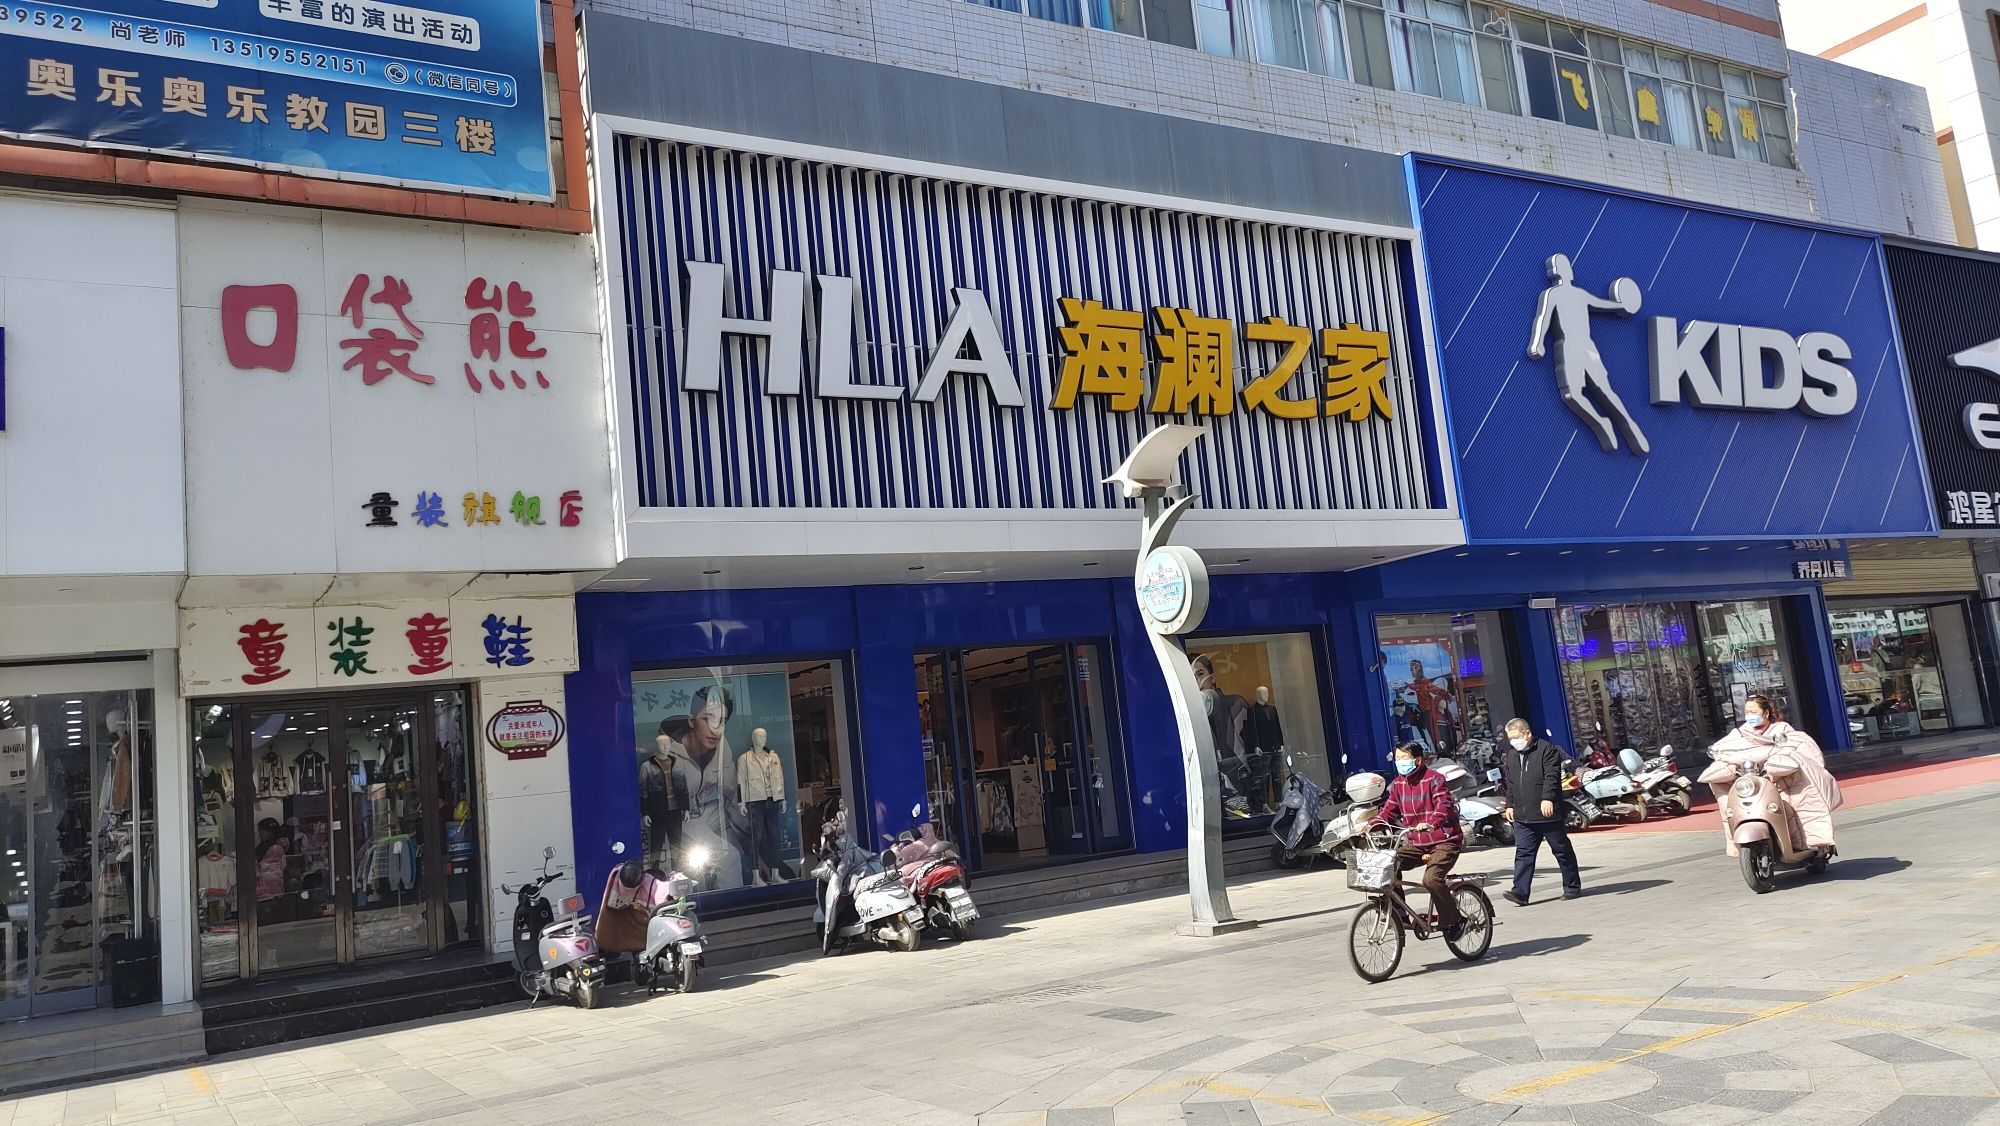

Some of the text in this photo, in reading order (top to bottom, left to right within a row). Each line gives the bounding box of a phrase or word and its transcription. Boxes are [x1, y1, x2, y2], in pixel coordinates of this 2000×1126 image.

[110, 21, 187, 48] 尚老师
[210, 37, 368, 75] 13519552151
[27, 58, 496, 155] 奥乐奥乐教园三楼
[222, 273, 550, 394] 口袋熊
[682, 259, 1393, 423] HLA 海澜之家
[1649, 315, 1858, 417] KIDS
[362, 489, 583, 529] 童装旗舰店
[1946, 490, 2000, 525] 鸿星
[1797, 560, 1847, 579] 乔丹儿童
[237, 612, 535, 686] 童装童鞋
